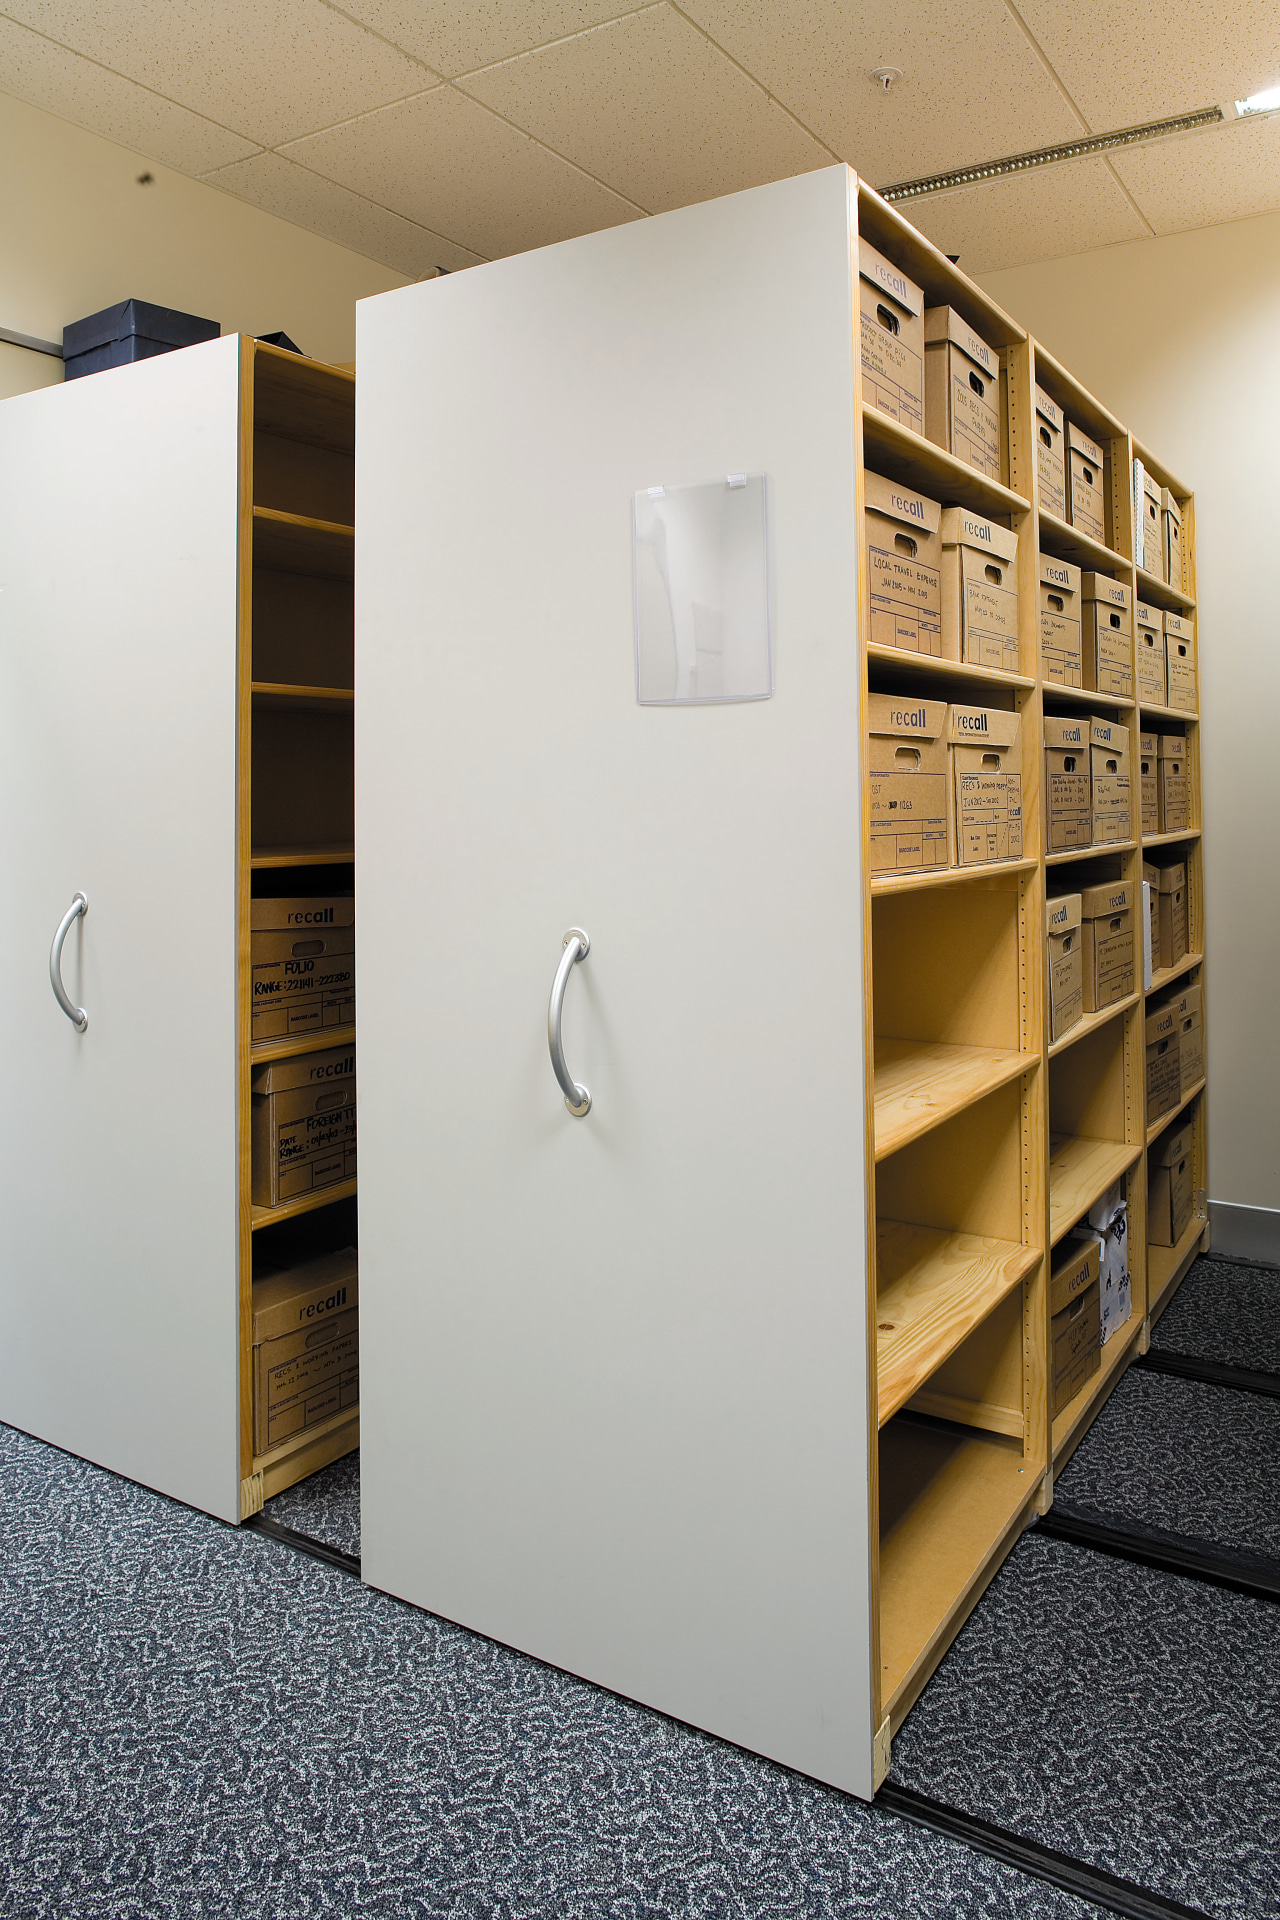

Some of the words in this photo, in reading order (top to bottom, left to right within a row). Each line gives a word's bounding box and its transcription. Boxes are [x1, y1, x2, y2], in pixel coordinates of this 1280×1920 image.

[875, 262, 908, 299] recall
[968, 336, 990, 366] recall
[891, 494, 925, 520] recall
[964, 520, 992, 543] recall
[874, 556, 892, 571] LOCAL
[894, 564, 913, 578] TRAVEL
[1046, 566, 1070, 585] recall
[1108, 588, 1125, 603] recall
[890, 709, 926, 728] recall
[957, 713, 988, 732] recall
[1062, 727, 1081, 742] recall
[1094, 726, 1112, 742] recall
[1109, 890, 1126, 908] recall
[288, 908, 334, 924] recall
[1051, 904, 1068, 925] recall
[285, 960, 315, 975] FOLIO
[1157, 1014, 1173, 1033] recall
[310, 1056, 354, 1080] recall
[306, 1111, 342, 1132] FOREIGN
[280, 1135, 297, 1147] DATE
[280, 1144, 304, 1159] RANGE
[1068, 1262, 1090, 1292] recall
[300, 1287, 347, 1321] recall
